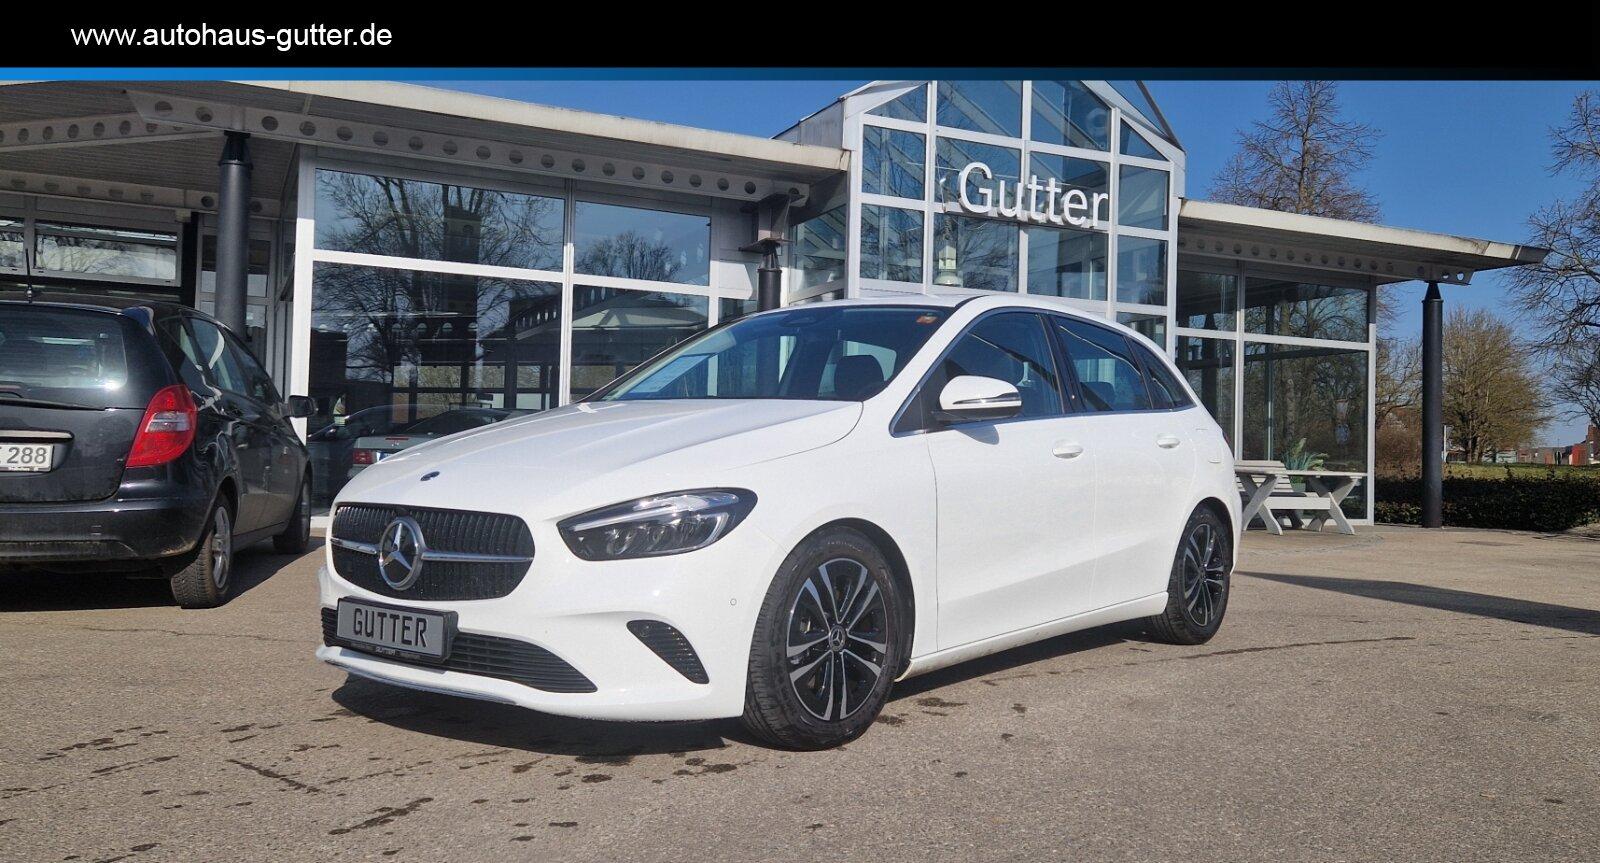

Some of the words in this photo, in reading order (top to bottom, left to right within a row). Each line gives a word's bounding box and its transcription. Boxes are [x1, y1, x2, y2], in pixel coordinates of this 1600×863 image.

[958, 162, 1109, 227] Gutter
[7, 447, 47, 464] 288
[353, 608, 427, 647] GUTTER
